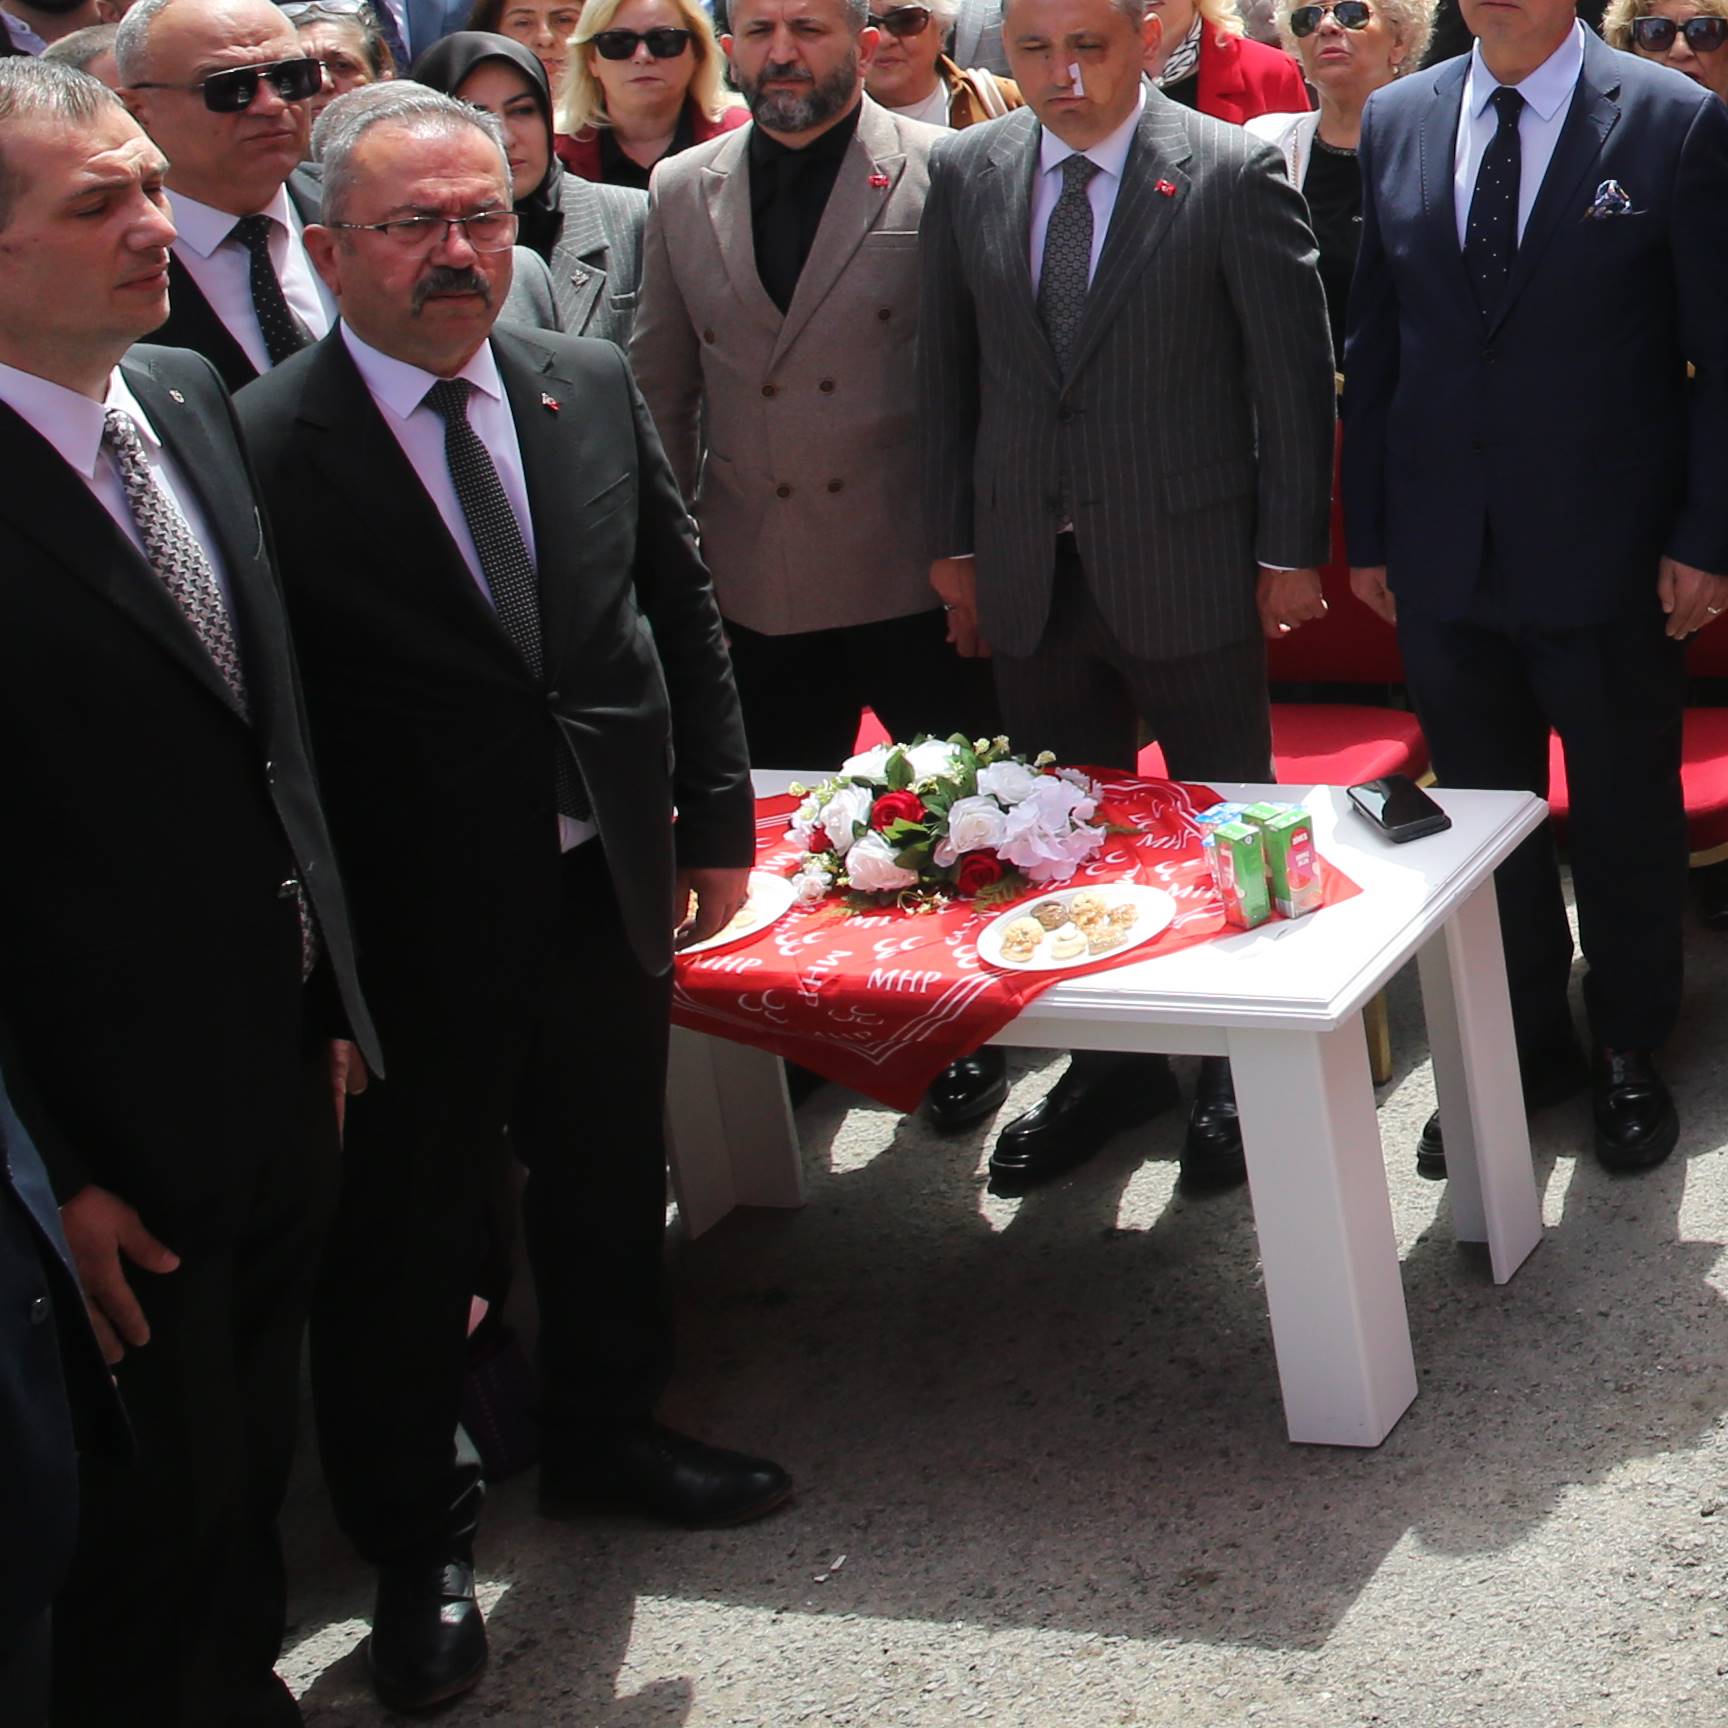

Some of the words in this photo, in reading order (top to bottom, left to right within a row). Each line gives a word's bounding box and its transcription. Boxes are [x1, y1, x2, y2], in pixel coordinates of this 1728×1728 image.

[684, 955, 763, 973] MHP
[798, 949, 853, 1008] MHP
[866, 967, 942, 993] MHP
